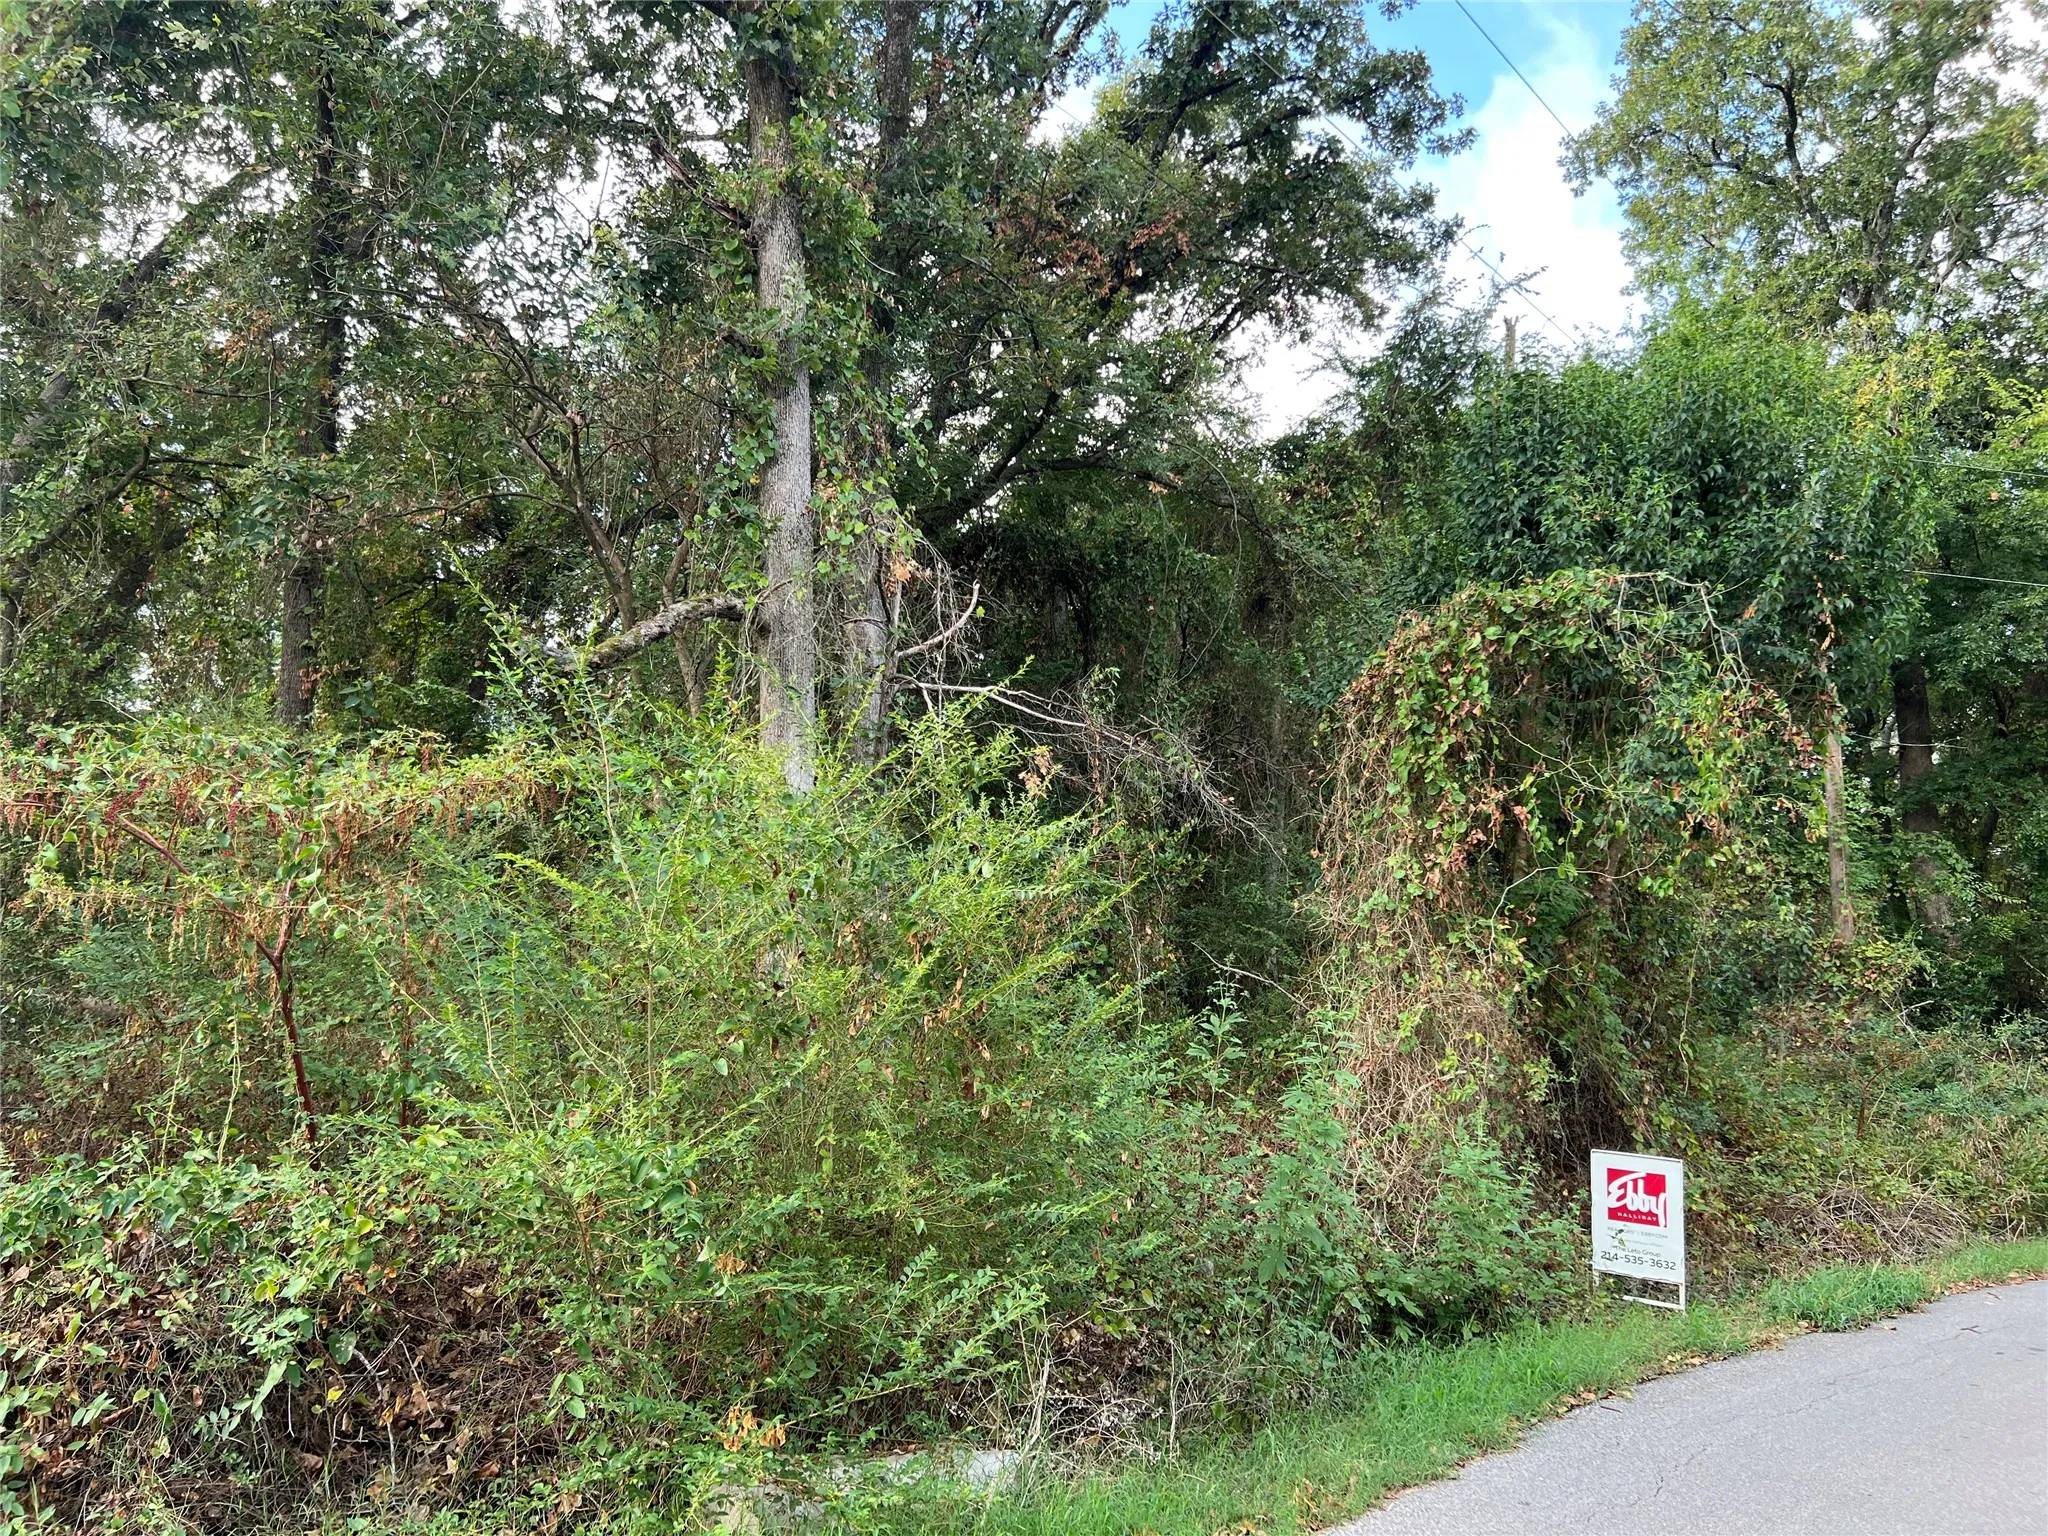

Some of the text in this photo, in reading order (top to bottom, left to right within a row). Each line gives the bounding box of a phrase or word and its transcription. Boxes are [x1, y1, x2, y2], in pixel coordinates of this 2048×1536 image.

[1607, 1172, 1667, 1228] Ebby
[1617, 1211, 1657, 1221] HALLIDAY
[1600, 1250, 1676, 1270] 214-535-3632
[1641, 1249, 1661, 1258] Group
